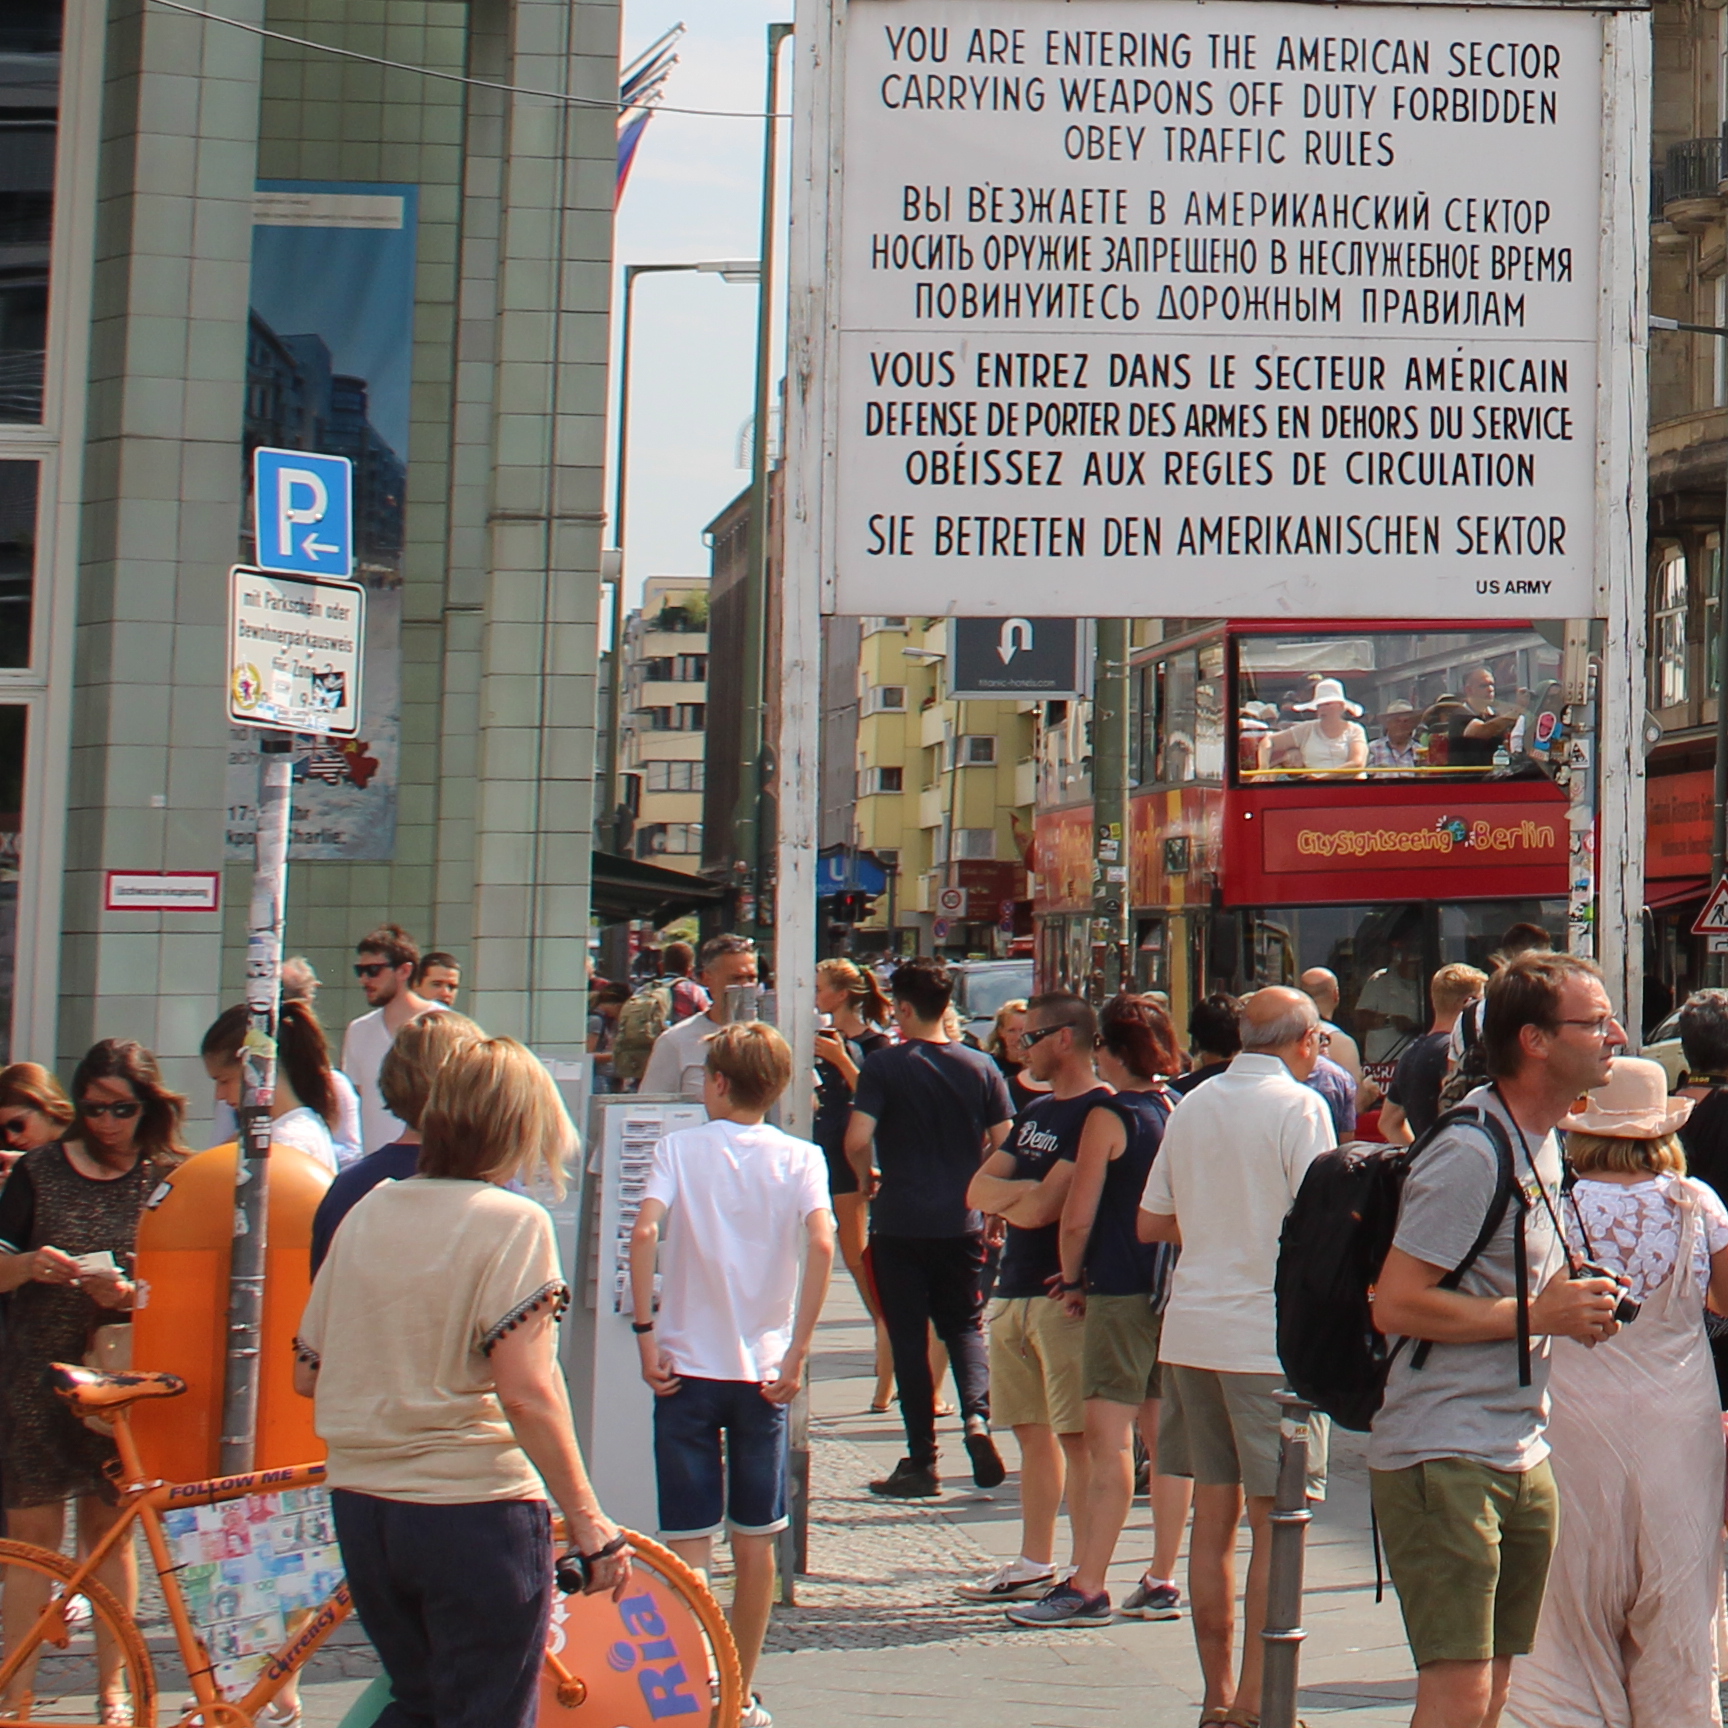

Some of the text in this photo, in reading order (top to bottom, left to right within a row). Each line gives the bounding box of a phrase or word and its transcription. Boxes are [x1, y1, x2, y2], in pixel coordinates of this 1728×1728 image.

[885, 25, 1561, 80] YOU ARE ENTERING THE AMERICAN SECTOR
[881, 73, 1556, 125] CARRYING WEAPONS OFF DUTY FORBIDDEN
[1064, 124, 1395, 167] OBEY TRAFFIC RULES
[903, 185, 951, 223] ВЫ
[1149, 189, 1166, 226] В
[1183, 190, 1429, 231] АМЕРИКАНСКИЙ
[1444, 197, 1551, 235] СЕКТОР
[872, 233, 974, 271] НОСИТЬ
[983, 234, 1092, 272] ОРУЖИЕ
[1270, 238, 1288, 275] В
[1299, 239, 1480, 280] НЕСЛУЖЕБНОЕ
[1491, 244, 1572, 283] ВРЕМЯ
[1156, 284, 1341, 323] ДОРОЖНЫМ
[1362, 288, 1525, 328] ПРАВИЛАМ
[870, 347, 1568, 394] VOUS ENTREZ DANS LE SECTEUR AMÉRICAIN
[865, 401, 1573, 441] DEFENSE DE PORTER DES ARMES EN DEHORS DU SERVICE
[905, 441, 1535, 488] OBÉISSEZ AUX REGLES DE CIRCULATION
[866, 513, 1566, 557] SIE BETRETEN DEN AMERIKANISCHEN SEKTOR
[243, 588, 350, 622] mit Parkschein oder
[1476, 579, 1552, 595] US ARMY
[239, 618, 354, 654] Bewohnerparkausweis
[1298, 820, 1555, 857] CitySightseeing Berlin
[169, 1467, 294, 1500] FOLLOW ME
[267, 1604, 337, 1681] Currency
